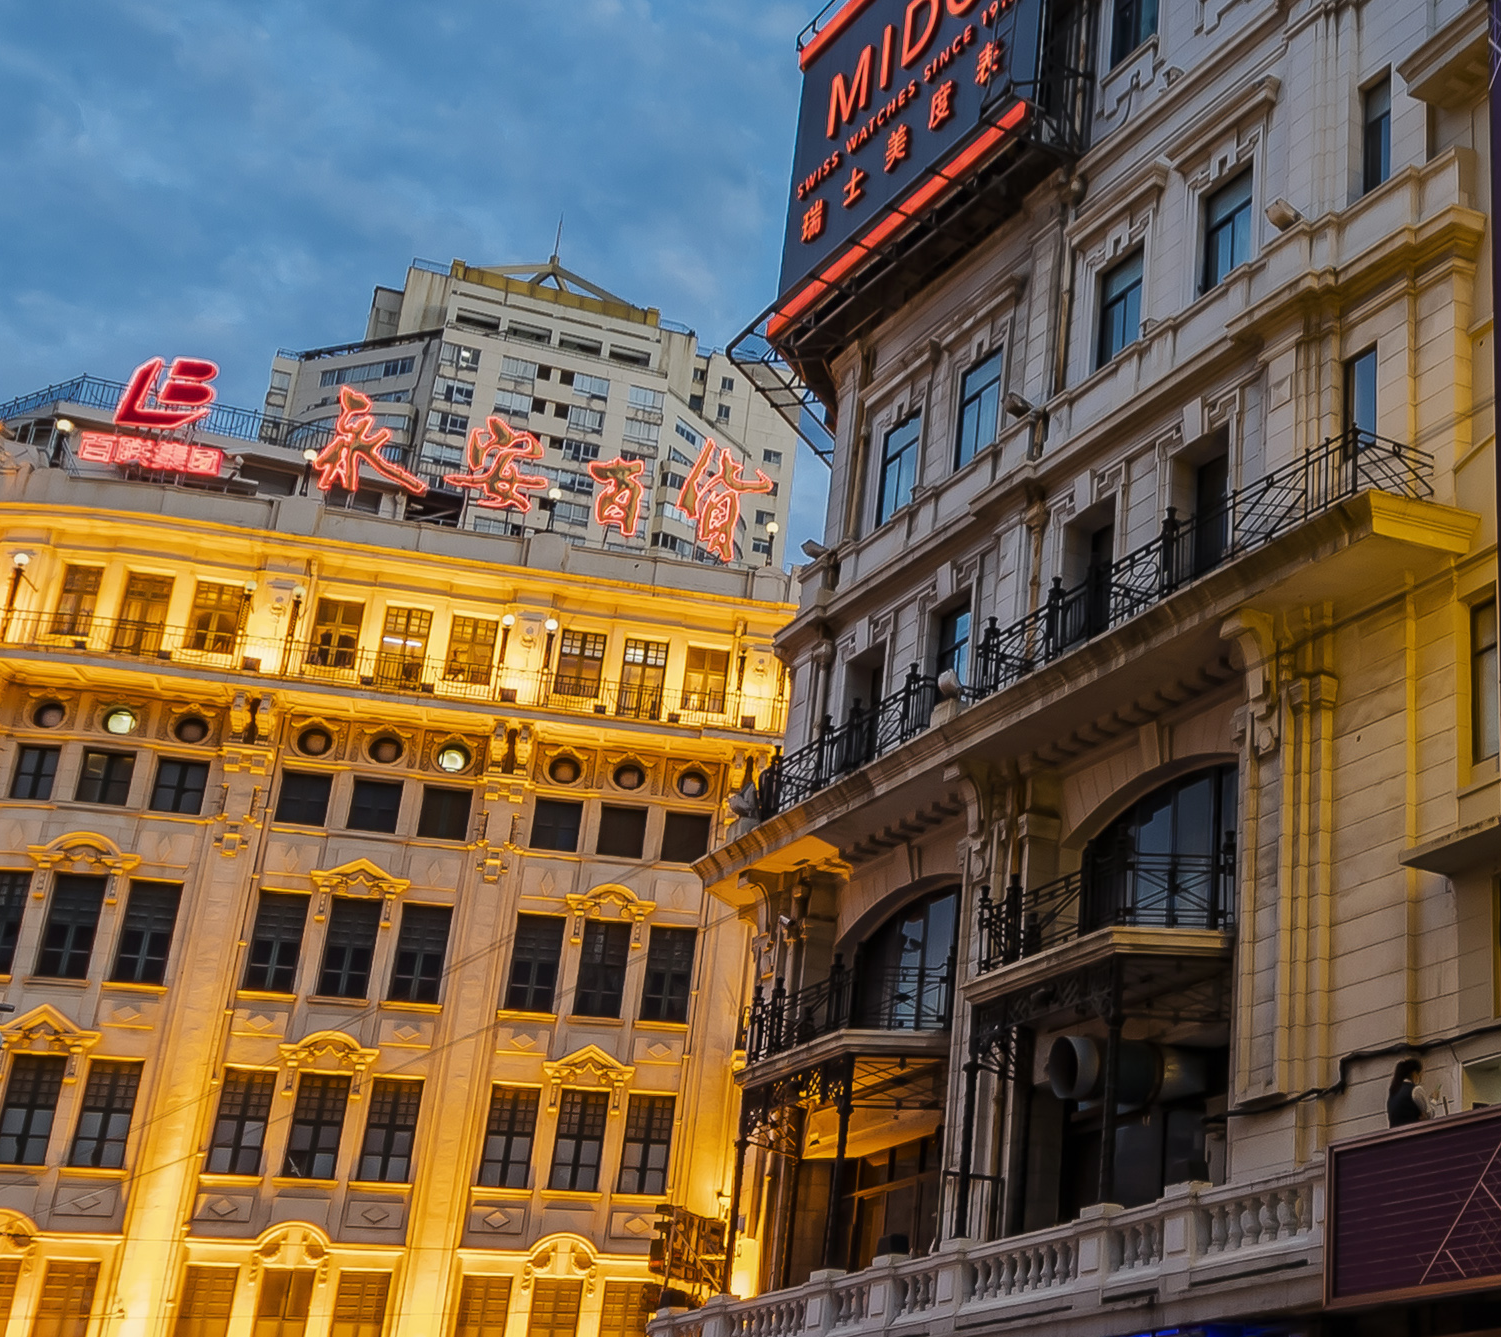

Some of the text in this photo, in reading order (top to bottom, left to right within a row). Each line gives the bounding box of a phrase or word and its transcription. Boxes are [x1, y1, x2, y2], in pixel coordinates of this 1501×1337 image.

[796, 150, 840, 200] SWISS
[845, 79, 917, 155] WATCHES
[923, 24, 973, 83] SINCE
[799, 40, 1000, 243] 瑞士美度表
